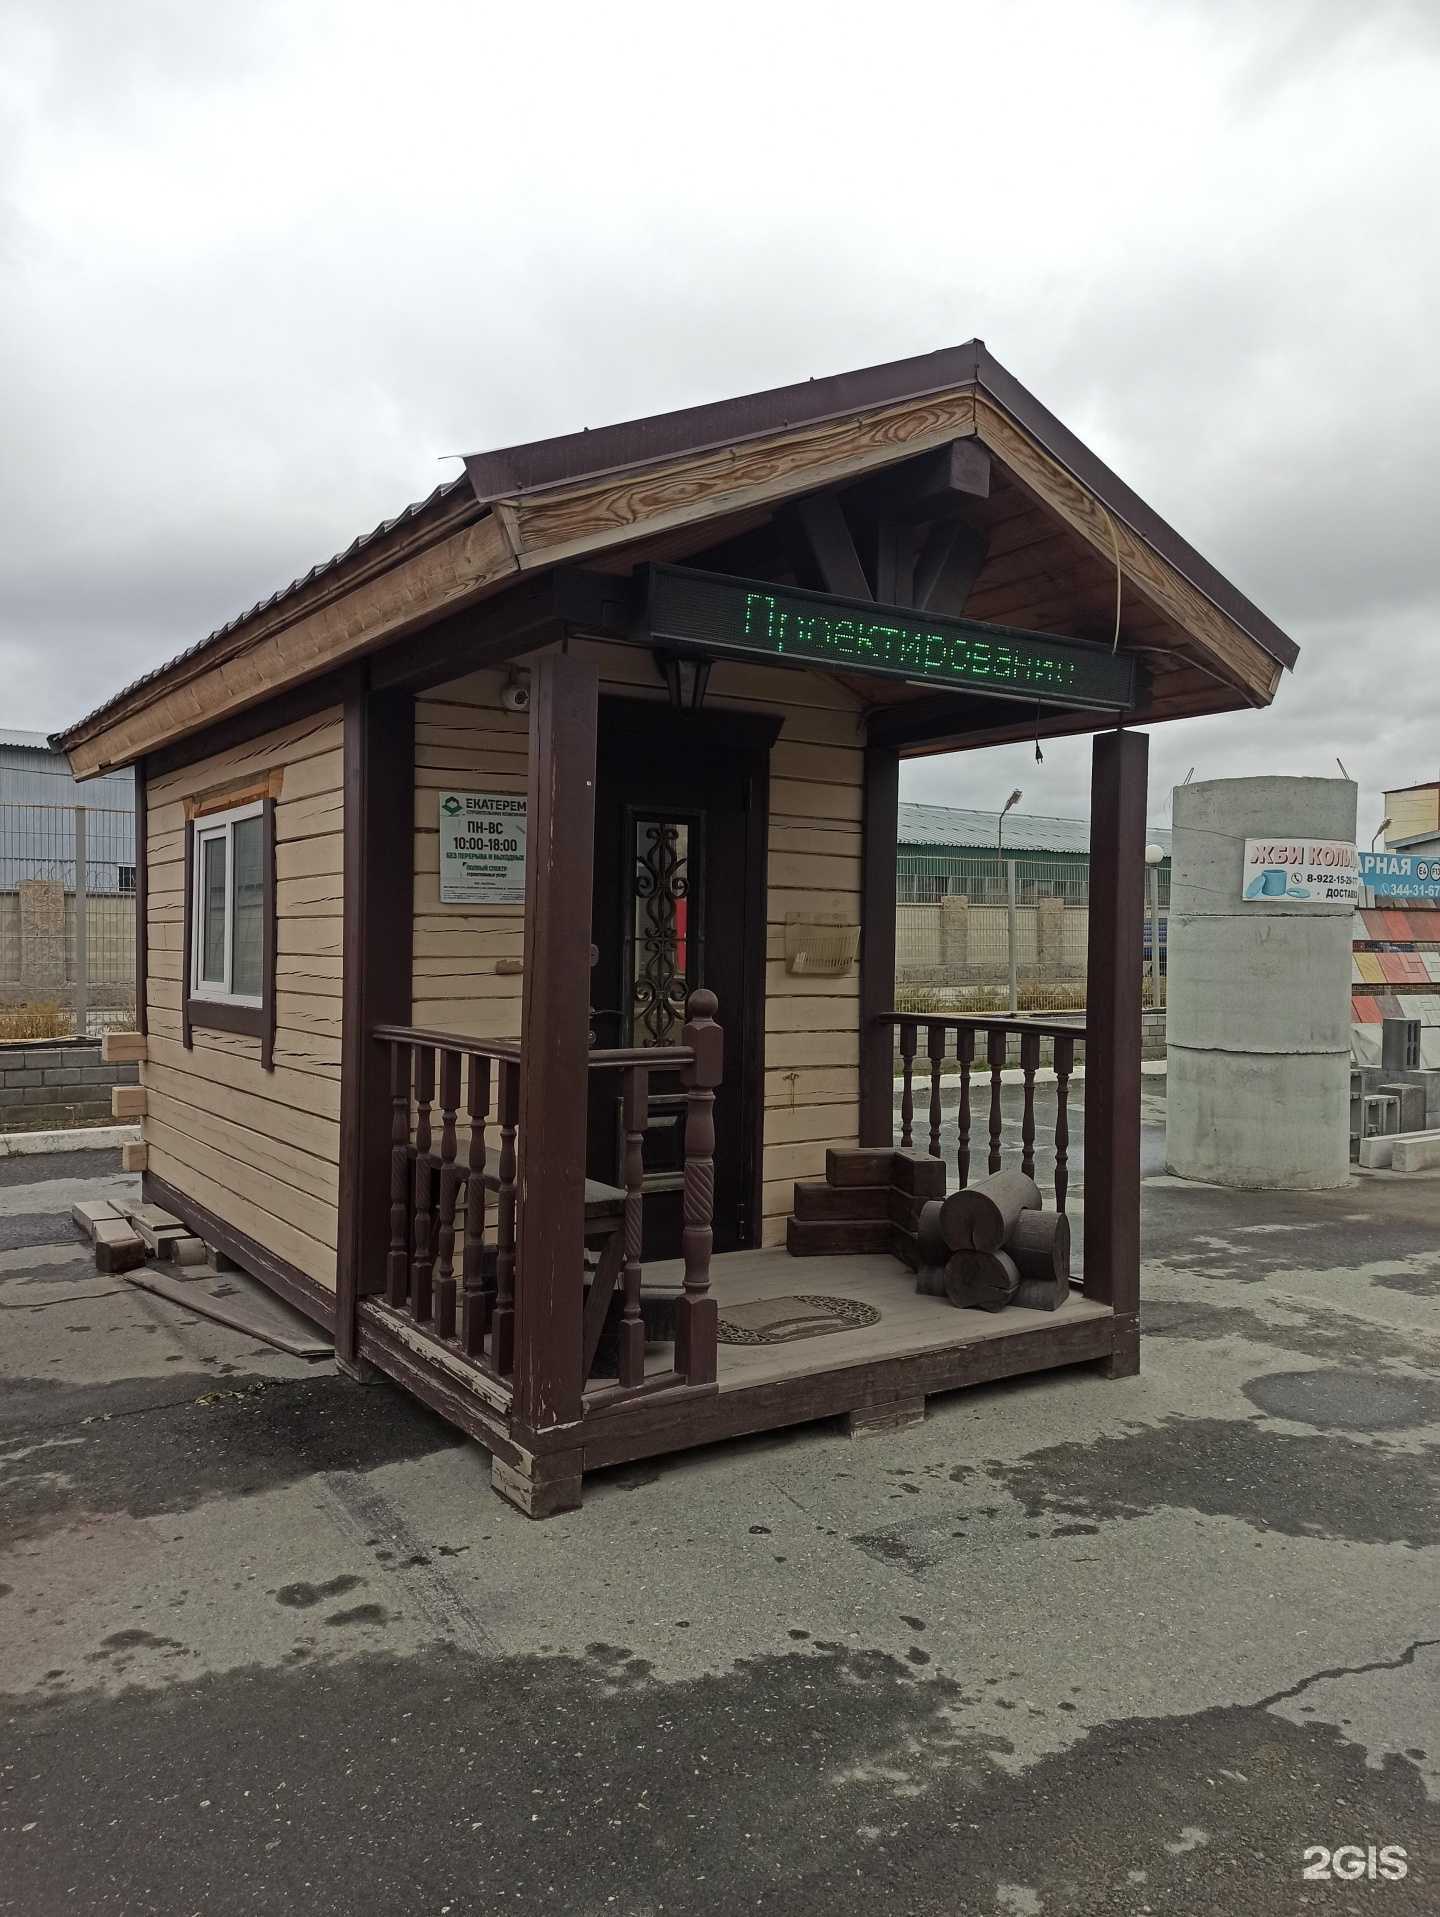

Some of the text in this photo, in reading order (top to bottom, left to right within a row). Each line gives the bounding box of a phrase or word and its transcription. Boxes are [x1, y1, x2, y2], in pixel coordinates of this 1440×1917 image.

[465, 798, 527, 811] ЕКАТЕРЕМ
[467, 821, 504, 834] ПН-ВС
[453, 837, 517, 851] 10:00-18:00
[1250, 846, 1305, 865] ЖБИ
